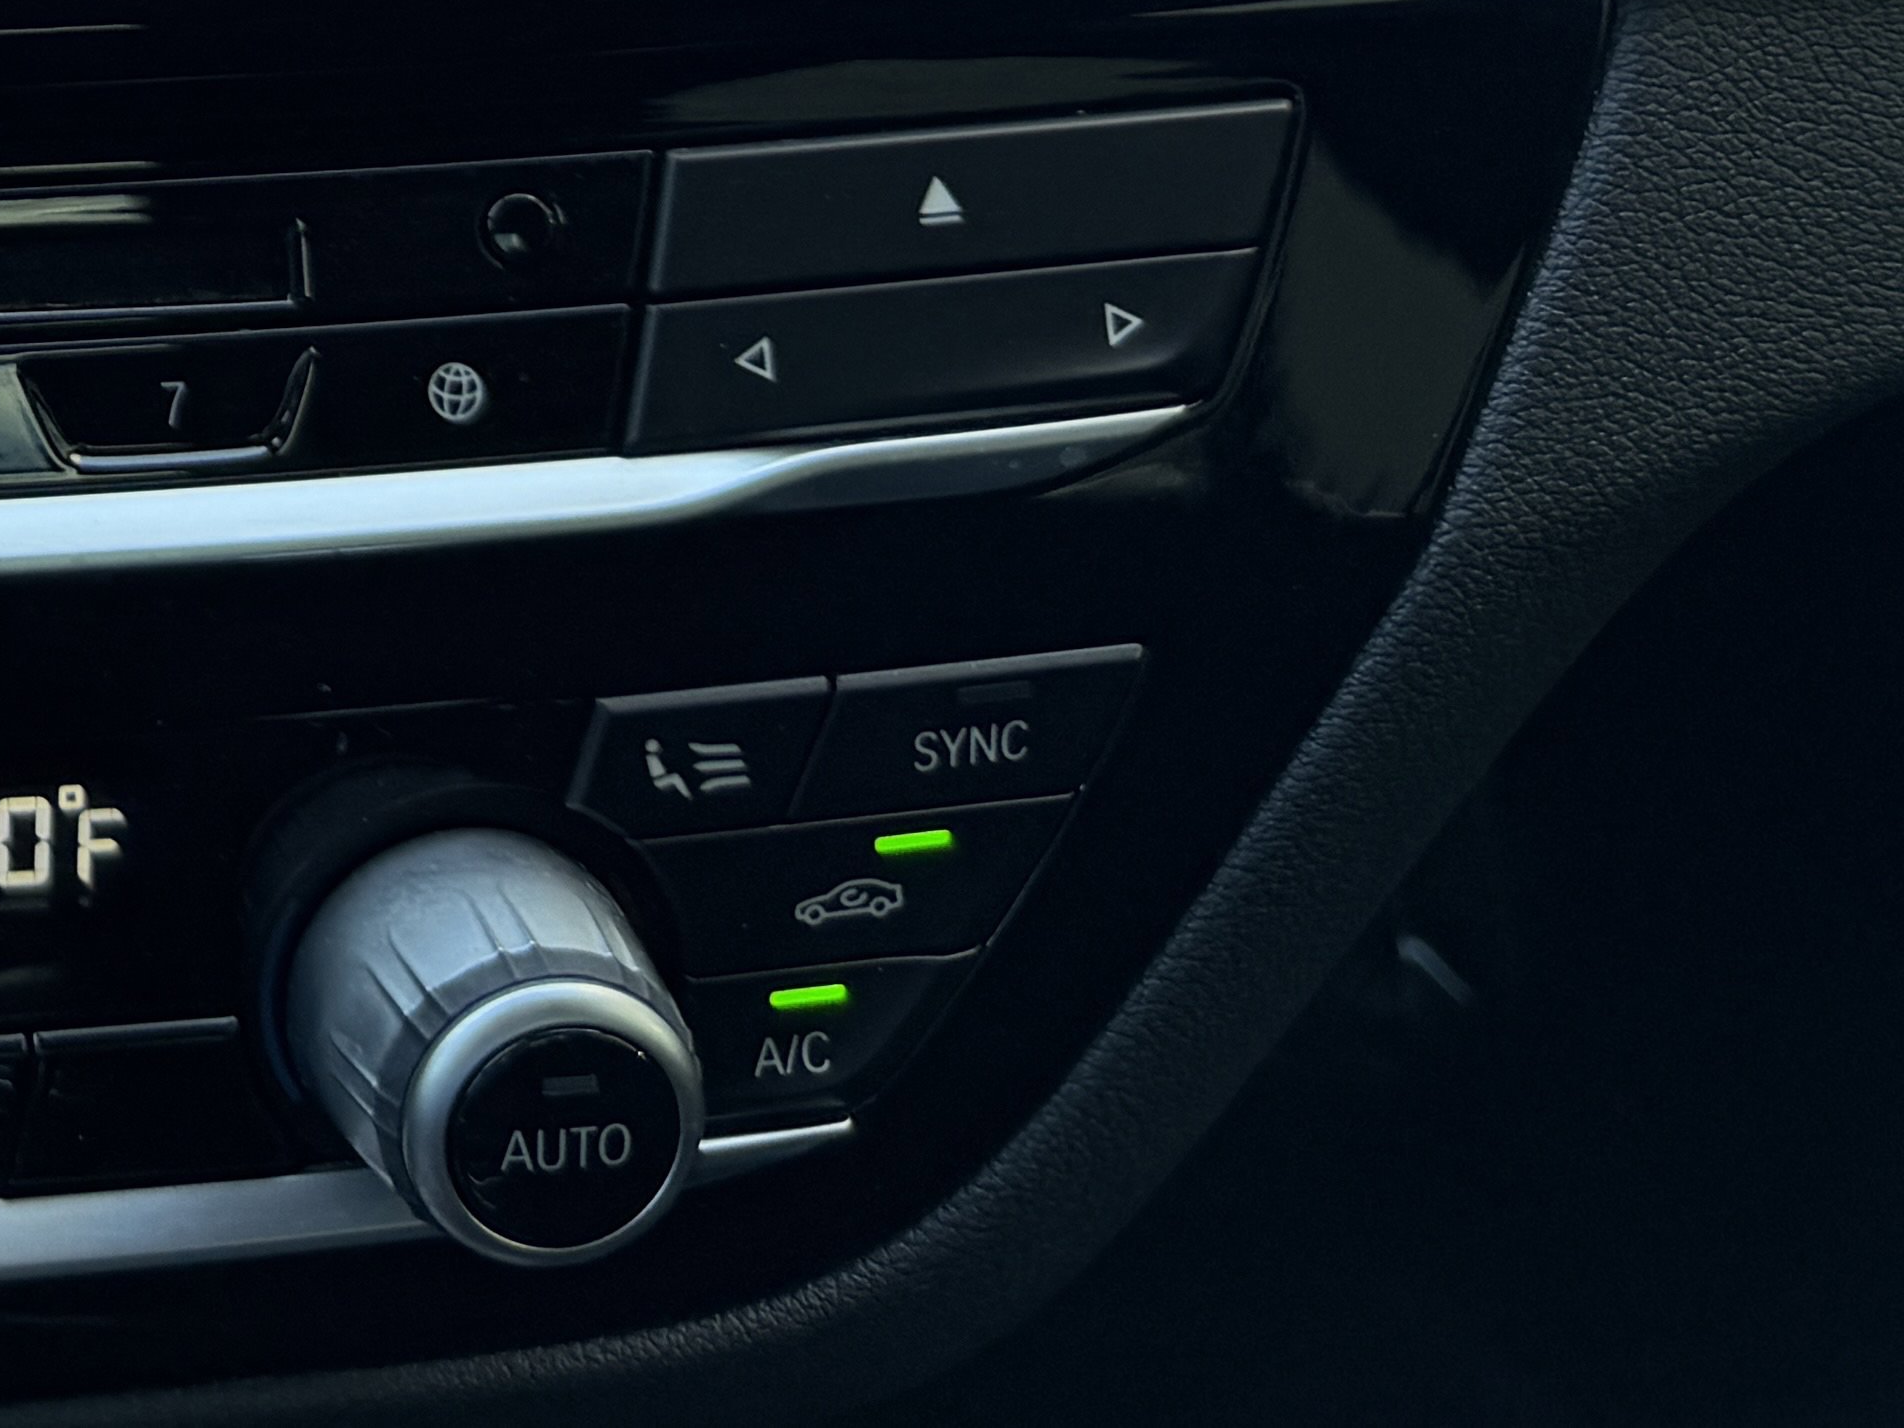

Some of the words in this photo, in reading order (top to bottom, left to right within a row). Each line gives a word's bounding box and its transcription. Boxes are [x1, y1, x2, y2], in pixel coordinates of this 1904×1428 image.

[160, 381, 188, 430] 7
[912, 720, 1031, 774] SYNC
[754, 1031, 832, 1077] A/C
[500, 1122, 634, 1175] AUTO
